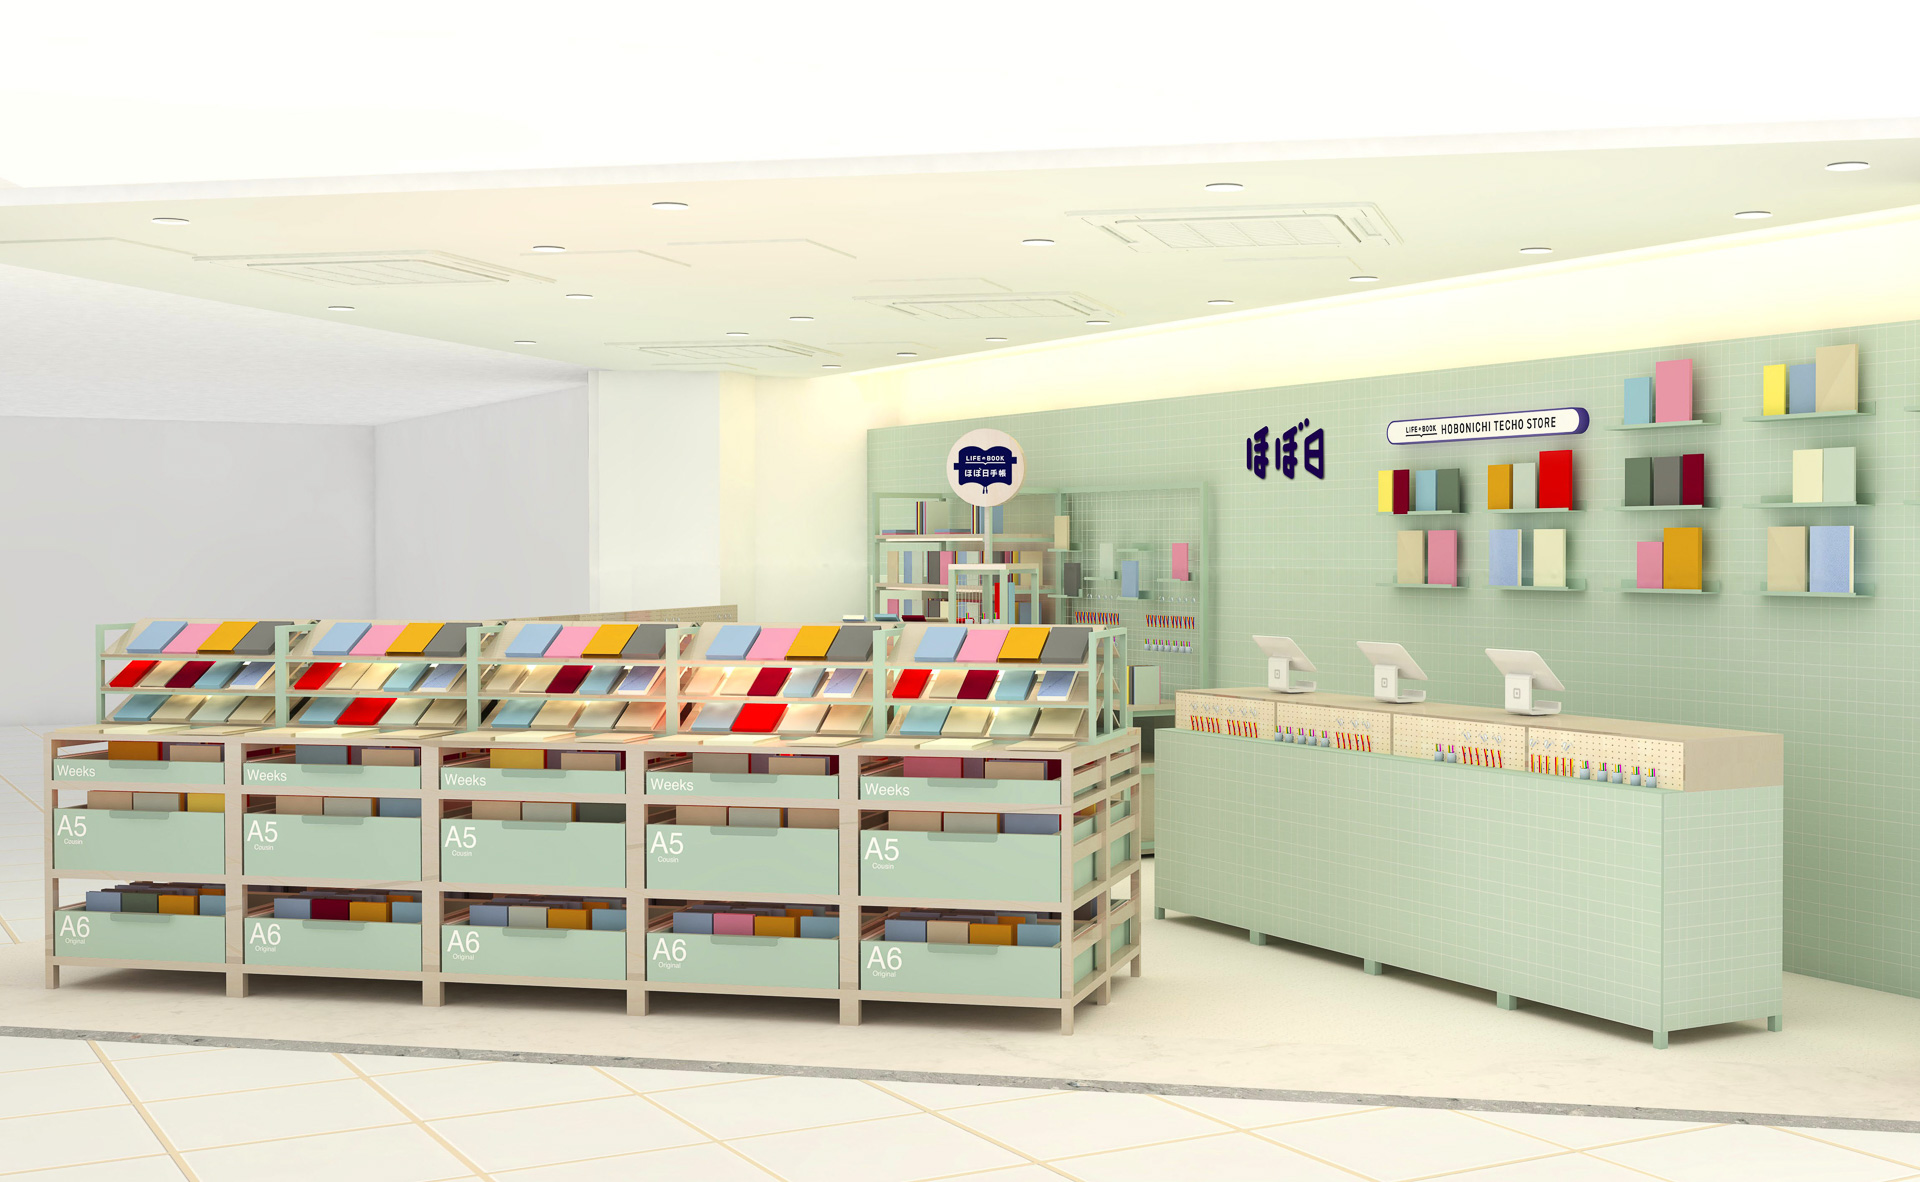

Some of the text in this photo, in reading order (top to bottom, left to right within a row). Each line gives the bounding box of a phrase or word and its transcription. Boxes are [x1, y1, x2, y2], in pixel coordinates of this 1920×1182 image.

[1405, 424, 1437, 434] LIFE BOOK
[1441, 416, 1557, 435] HOBONICHI TECHO STORE
[1246, 417, 1324, 480] ほぼ日
[964, 467, 1007, 478] ほぼ日手帳
[57, 764, 96, 777] Weeks
[247, 769, 287, 781] Weeks
[444, 773, 486, 787] Weeks
[650, 778, 694, 791] Weeks
[864, 783, 910, 797] Weeks
[57, 815, 87, 836] A5
[247, 820, 278, 843] A5
[444, 826, 477, 849] A5
[650, 831, 684, 854] A5
[864, 837, 899, 861] A5
[60, 915, 90, 937] A6
[249, 922, 281, 946] A6
[65, 937, 86, 945] Original
[254, 944, 277, 953] Original
[446, 930, 480, 953] A6
[452, 952, 475, 961] Original
[652, 938, 687, 962] A6
[866, 946, 902, 970] A6
[658, 961, 682, 970] Original
[872, 969, 898, 978] Original
